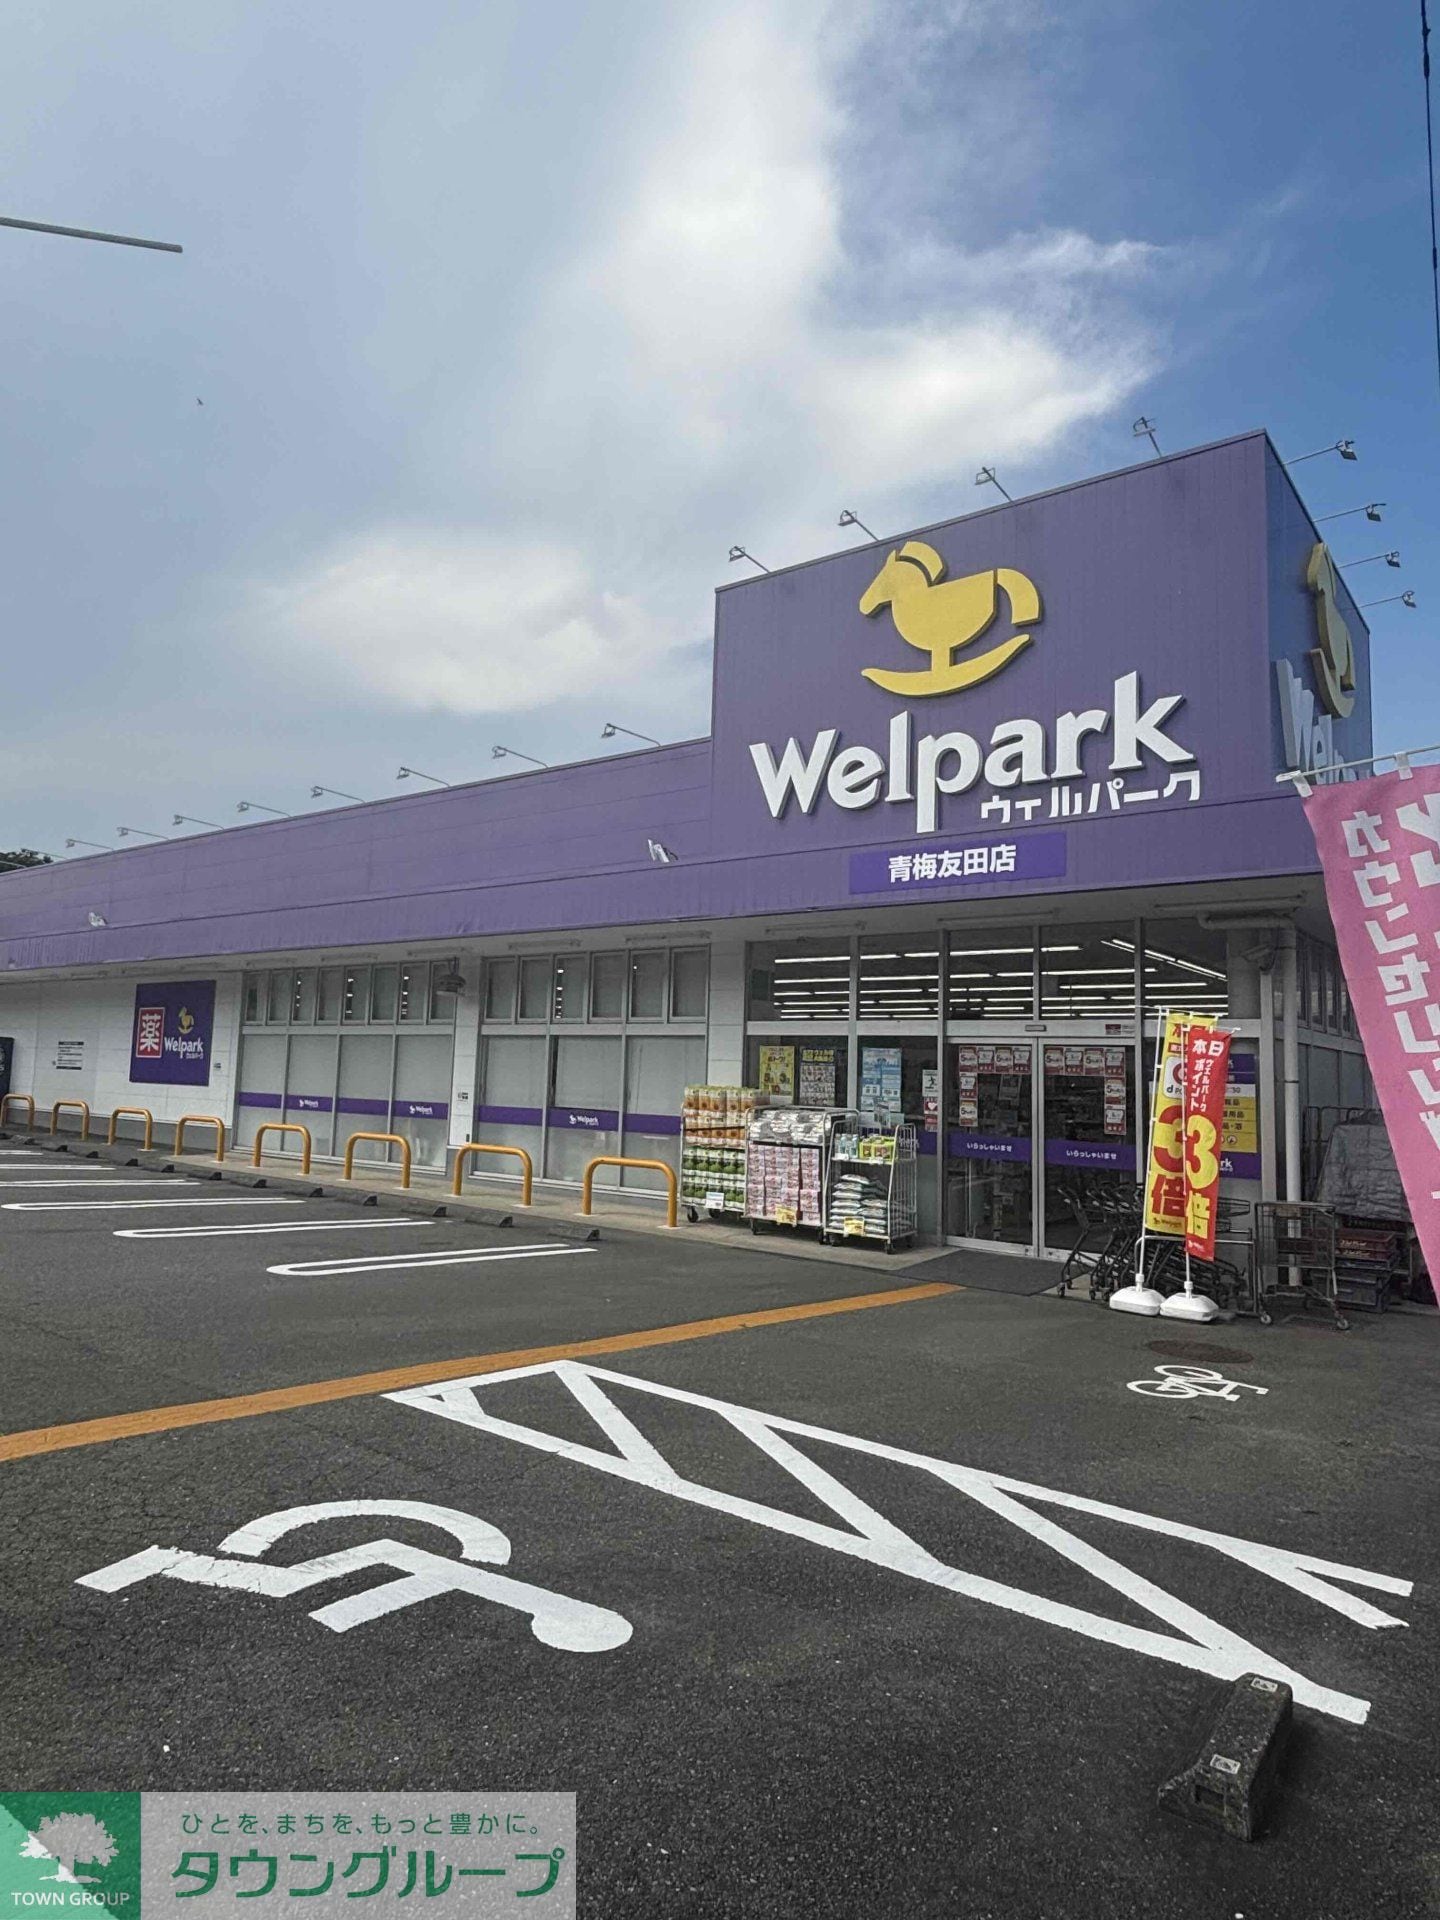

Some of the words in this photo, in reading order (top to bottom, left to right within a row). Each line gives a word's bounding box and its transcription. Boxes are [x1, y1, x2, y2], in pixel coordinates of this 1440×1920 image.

[749, 671, 1196, 834] Welpark
[888, 844, 1017, 883] 青梅友田店
[140, 1013, 161, 1052] 薬
[164, 1036, 204, 1059] Welpark
[1192, 1039, 1225, 1057] 本日
[1066, 1149, 1117, 1160] いらっしゃいませ
